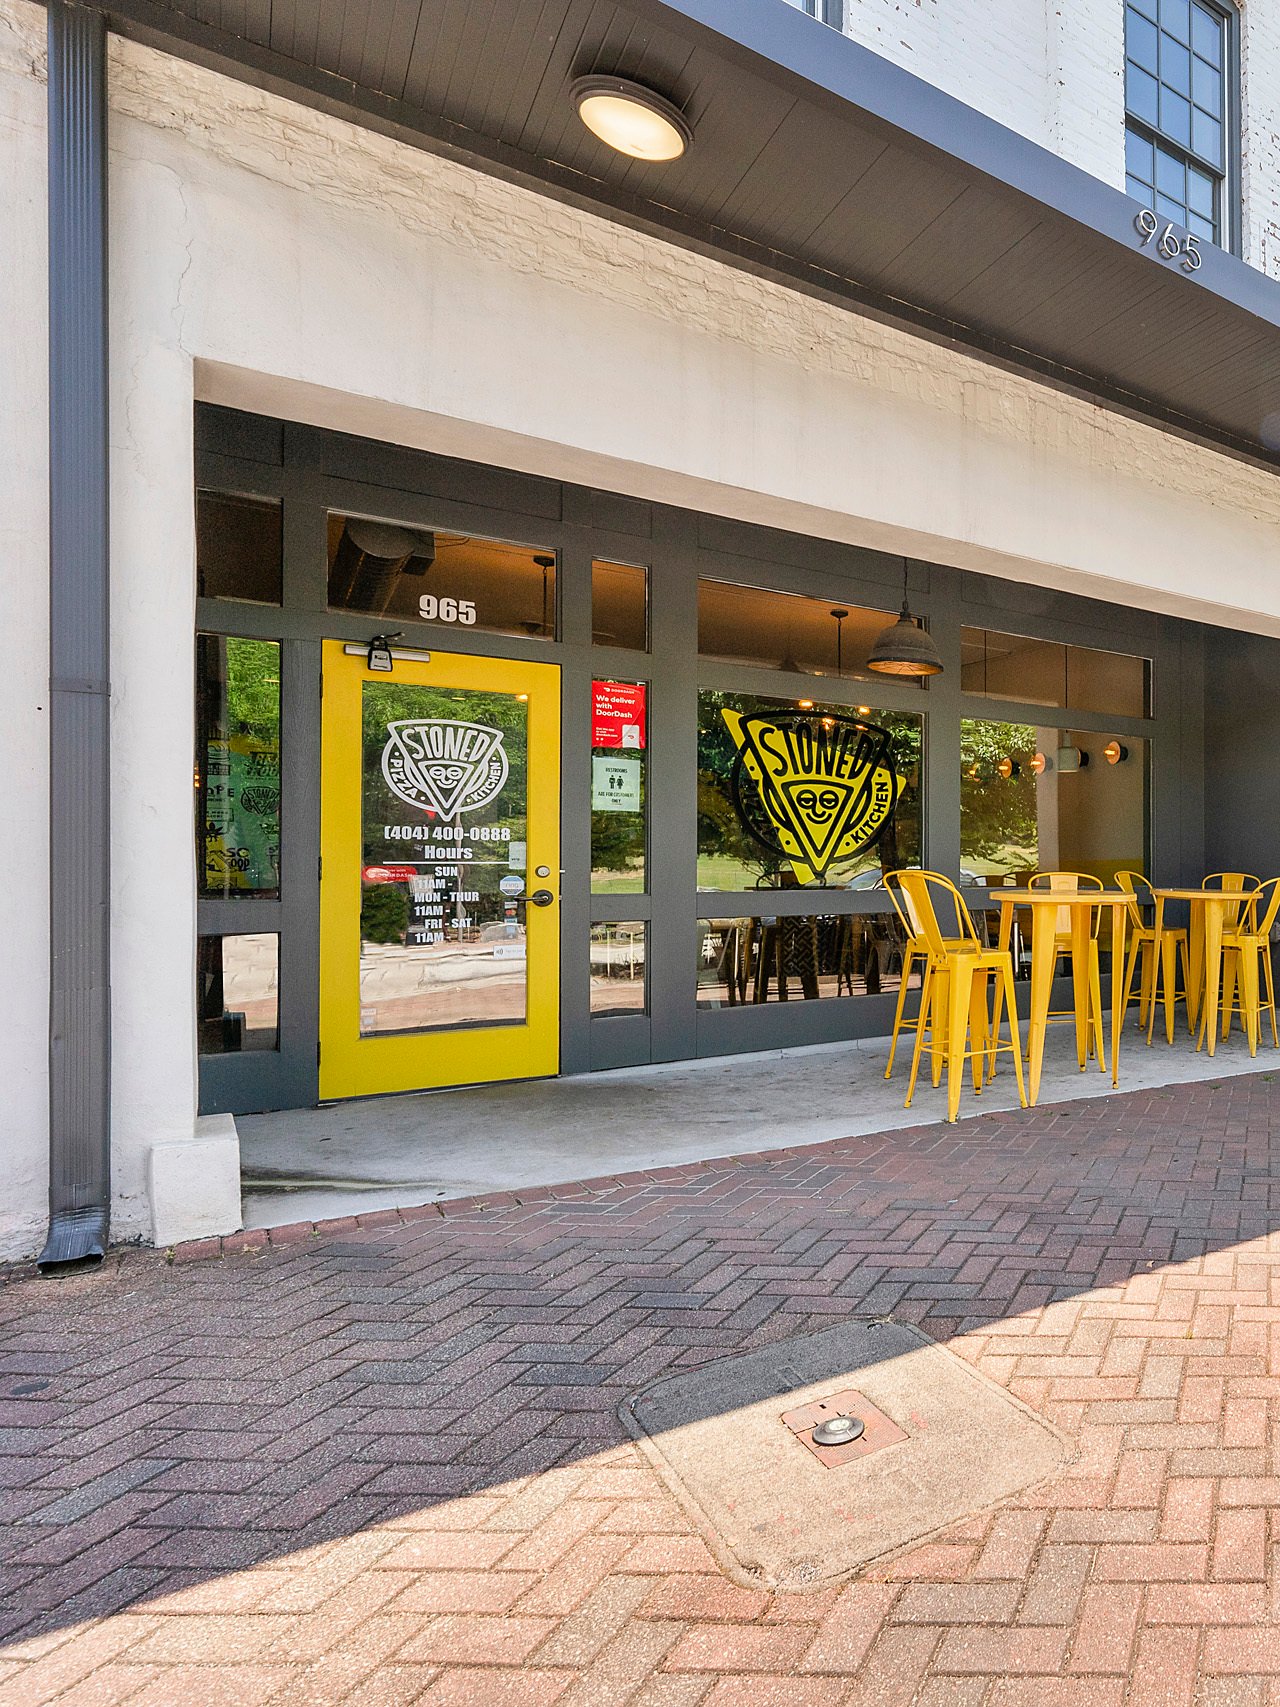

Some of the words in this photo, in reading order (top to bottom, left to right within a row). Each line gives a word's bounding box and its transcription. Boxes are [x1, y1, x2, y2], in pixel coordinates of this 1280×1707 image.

[1137, 210, 1201, 271] 965
[419, 594, 477, 625] 965
[596, 694, 609, 702] We
[610, 696, 635, 705] deliver
[596, 709, 632, 718] DoorDash
[402, 725, 491, 762] STONED
[758, 722, 876, 780] STONED
[390, 758, 418, 799] PIZZA
[470, 761, 502, 801] KITCHEN
[849, 781, 889, 845] KITCHEN
[384, 825, 429, 840] (404)
[432, 826, 511, 841] 400-0888
[424, 845, 473, 859] Hours
[434, 866, 458, 877] SUN
[418, 879, 446, 889] 11AM
[414, 892, 441, 902] MON
[449, 892, 480, 902] THUR
[414, 905, 443, 916] 11AM
[424, 919, 442, 929] FRI
[451, 918, 472, 928] SAT
[414, 932, 444, 943] 11AM
